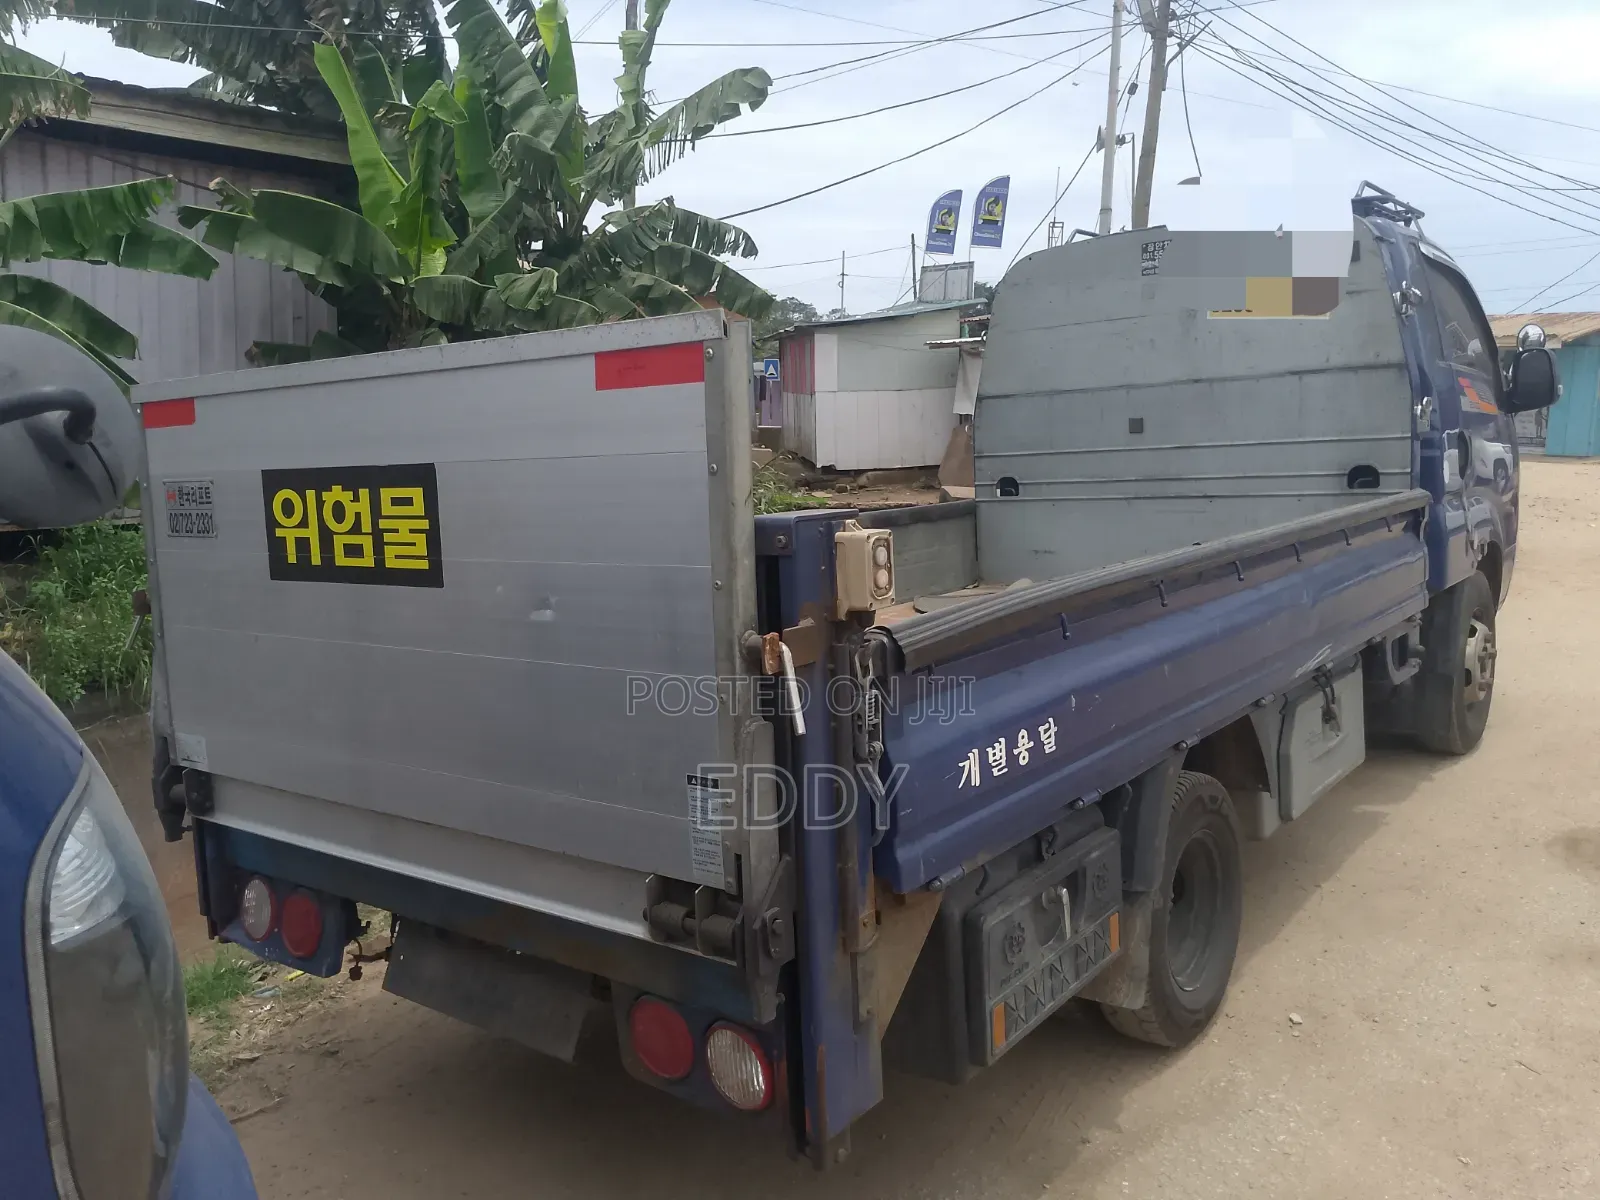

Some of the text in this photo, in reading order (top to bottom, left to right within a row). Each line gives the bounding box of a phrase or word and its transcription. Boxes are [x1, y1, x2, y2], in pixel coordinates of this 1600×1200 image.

[177, 485, 213, 507] 한국리프트
[272, 485, 430, 570] 위험물
[957, 717, 1058, 789] 개별용달
